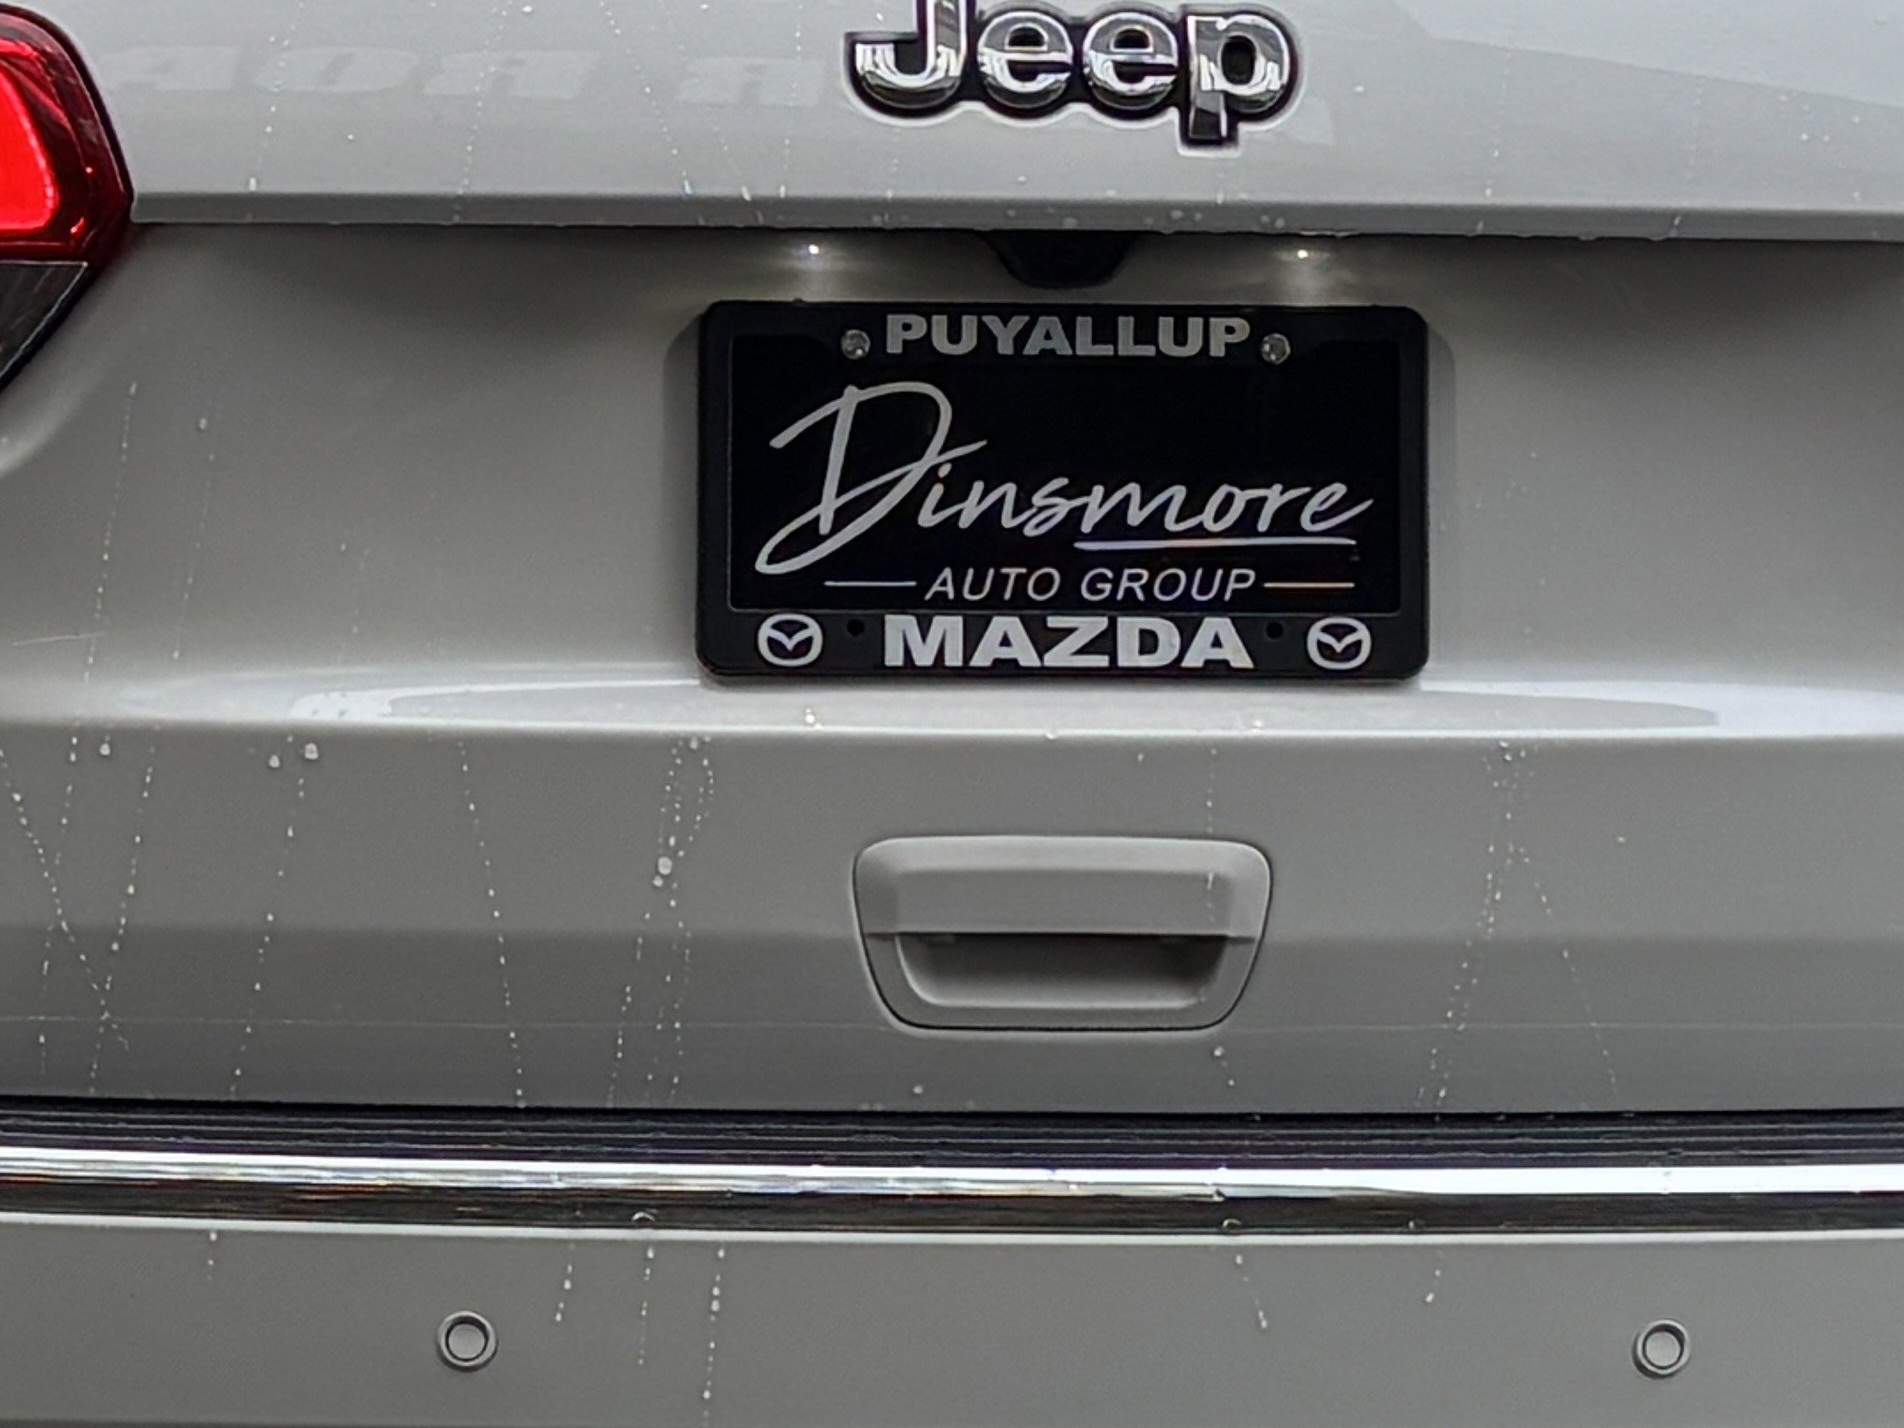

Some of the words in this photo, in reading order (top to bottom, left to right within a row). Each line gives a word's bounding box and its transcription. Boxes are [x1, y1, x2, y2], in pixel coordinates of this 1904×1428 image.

[885, 313, 1251, 358] PUYALLUP
[754, 380, 1375, 575] Dinsmore
[924, 567, 1062, 602] AUTO
[1080, 567, 1257, 603] GROUP
[883, 613, 1255, 669] MAZDA
